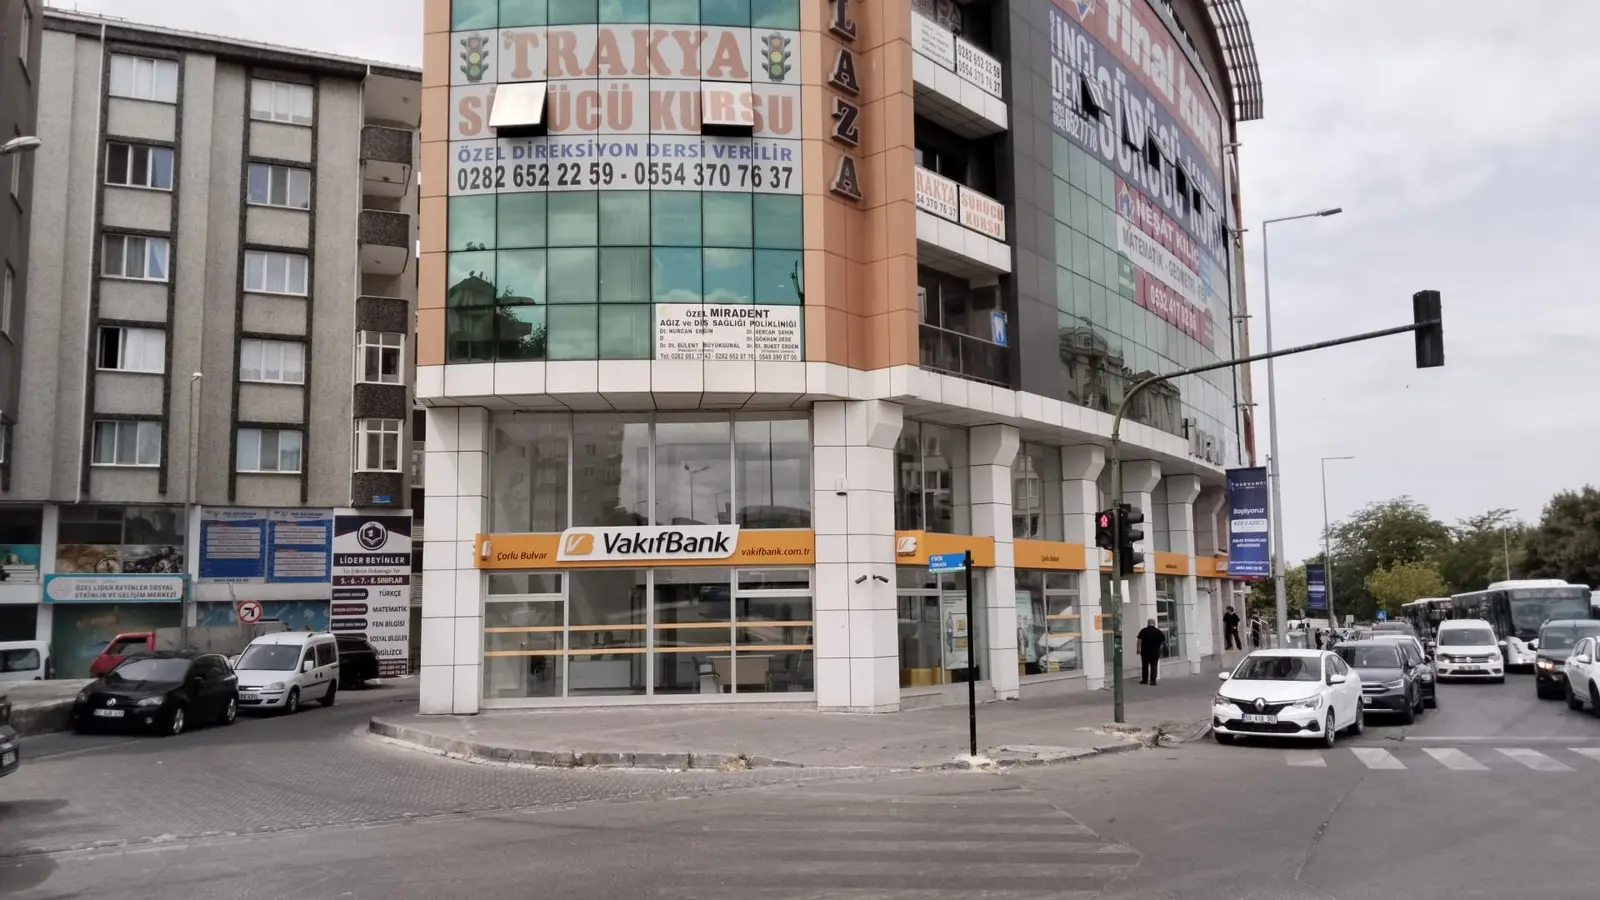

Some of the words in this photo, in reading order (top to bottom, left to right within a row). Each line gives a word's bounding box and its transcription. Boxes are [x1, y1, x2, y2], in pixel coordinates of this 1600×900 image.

[501, 28, 749, 79] TRAKYA
[458, 83, 633, 137] SÜCÜ
[650, 90, 793, 135] KURSU
[458, 145, 506, 163] ÖZEL
[513, 139, 638, 160] DİREKSİYON
[646, 140, 706, 158] DERSİ
[713, 142, 793, 162] VERİLİR
[457, 165, 506, 191] 0282
[513, 164, 550, 188] 652
[557, 162, 581, 186] 22
[589, 162, 614, 186] 59
[634, 162, 686, 185] 0554
[693, 163, 730, 187] 370
[738, 165, 763, 188] 76
[769, 166, 793, 189] 37
[686, 309, 708, 318] ÖZEL
[710, 306, 770, 318] MİRADENT
[660, 318, 680, 327] AĞIZ
[712, 318, 746, 328] SAĞLIĞI
[603, 531, 730, 555] VakıfBank
[496, 551, 519, 562] Çorlu
[520, 550, 548, 560] Bulvar
[741, 547, 811, 557] vakifbank.com.tr
[339, 555, 364, 564] LİDER
[365, 554, 405, 564] BEYİNLER
[378, 588, 402, 598] TÜRKÇE
